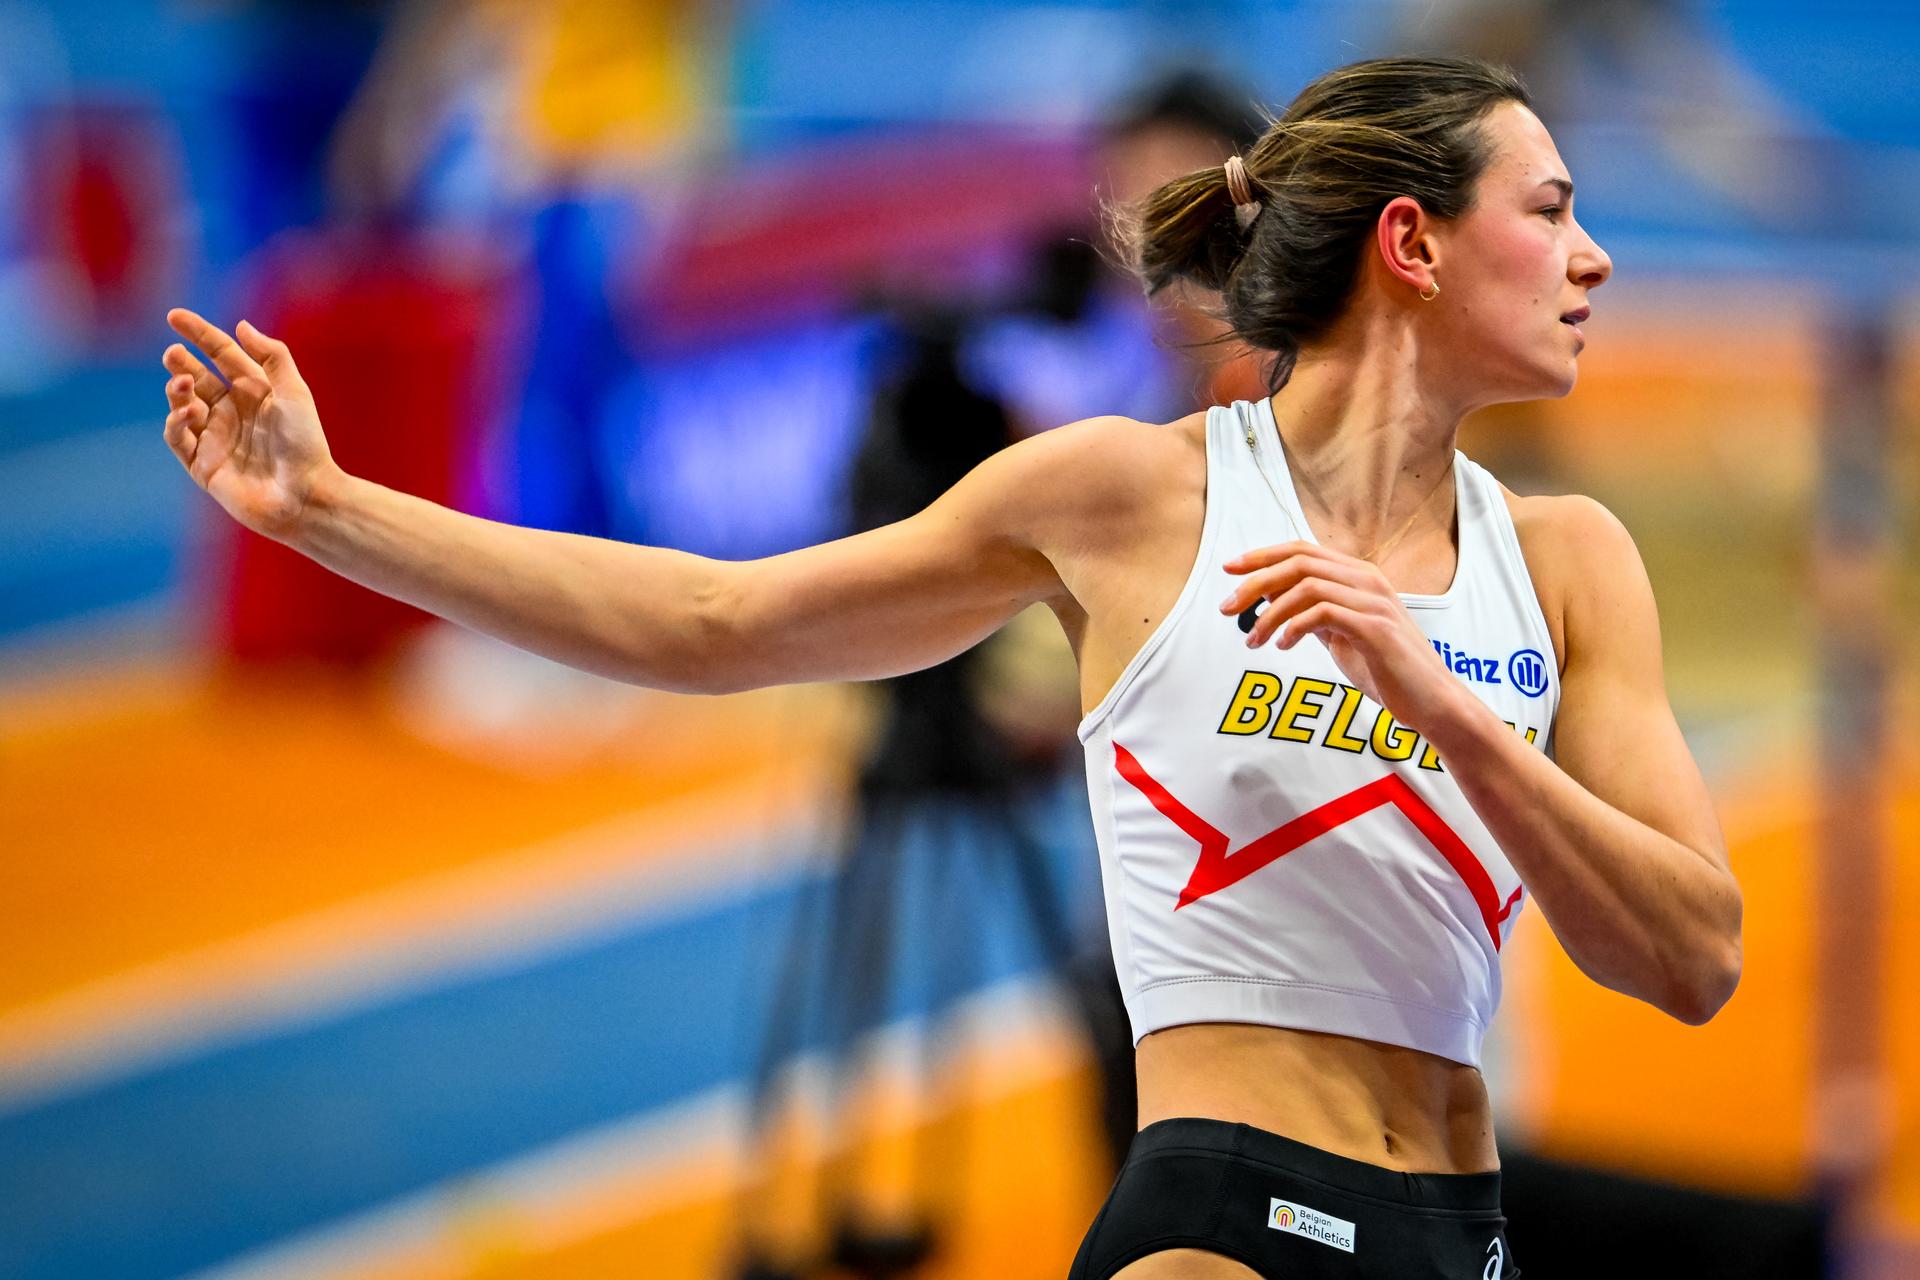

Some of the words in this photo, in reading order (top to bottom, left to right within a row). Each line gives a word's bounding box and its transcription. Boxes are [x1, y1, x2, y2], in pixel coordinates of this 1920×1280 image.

[1427, 638, 1502, 684] ianz
[1217, 669, 1538, 773] BELG
[1298, 1221, 1351, 1248] Athletics
[1299, 1209, 1332, 1228] Belgian
